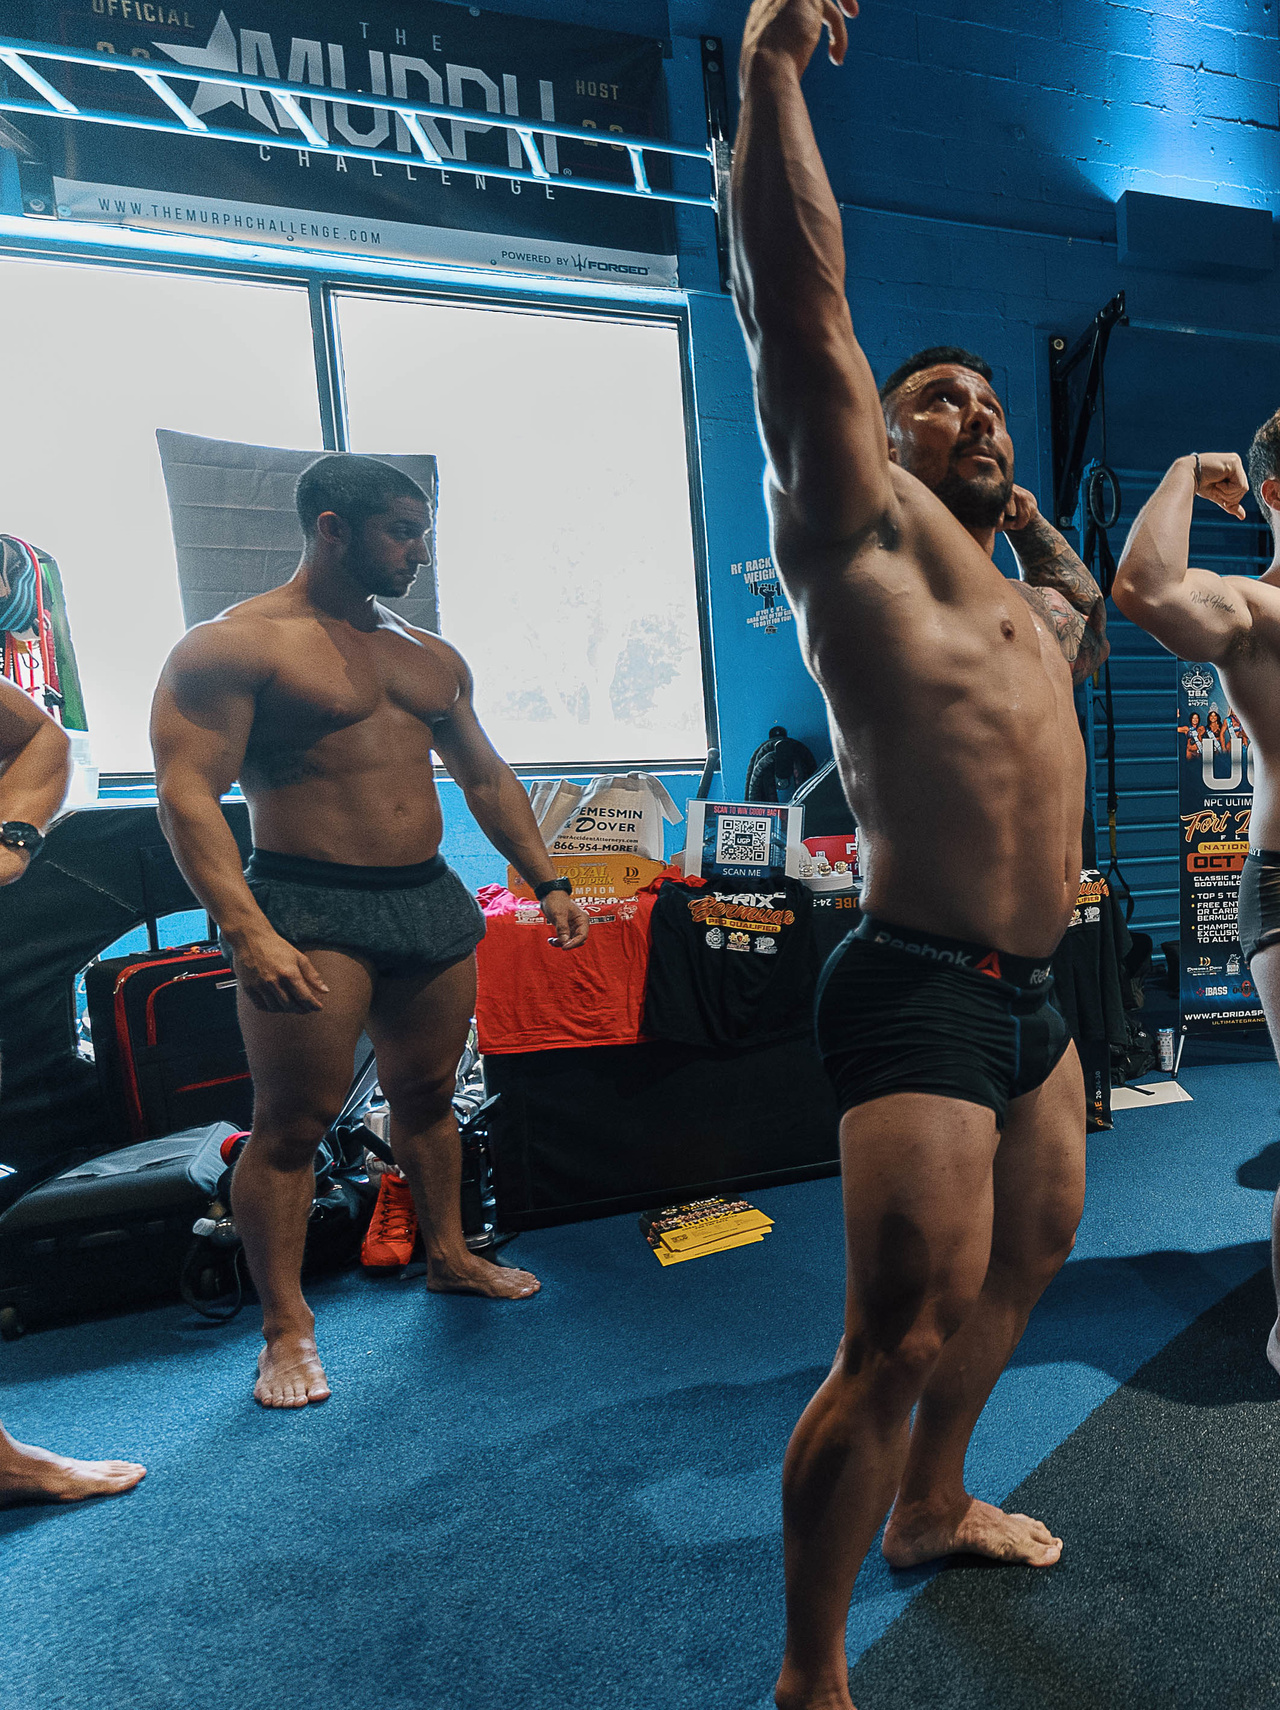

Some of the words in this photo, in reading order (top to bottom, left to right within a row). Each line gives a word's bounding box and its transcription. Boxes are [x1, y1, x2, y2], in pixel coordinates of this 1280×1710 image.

[91, 0, 196, 29] OFFICIAL
[359, 22, 443, 53] THE
[575, 79, 619, 100] HOST
[239, 28, 559, 174] MURPH
[258, 144, 556, 200] CHALLENGE
[98, 197, 382, 245] WWW.THEMURPHCHALLENGE.COM
[501, 250, 551, 264] POWERED
[556, 257, 569, 266] BY
[588, 260, 650, 276] FORGED
[745, 556, 772, 573] RACK
[713, 805, 728, 814] SCAN
[1203, 798, 1223, 807] NPC
[578, 806, 643, 820] EMESMIN
[575, 816, 636, 833] DOVER
[1180, 809, 1232, 842] Fort
[553, 841, 634, 853] 866-954-MORE
[736, 836, 751, 845] UGP
[1203, 843, 1248, 851] NATION
[1193, 855, 1235, 869] OCT
[722, 867, 746, 876] SCAN
[748, 868, 761, 877] ME
[573, 886, 616, 896] MPION
[708, 918, 727, 926] PRO
[729, 920, 778, 932] QUALIFIER
[1184, 1009, 1265, 1021] WWW.FLORIDASP
